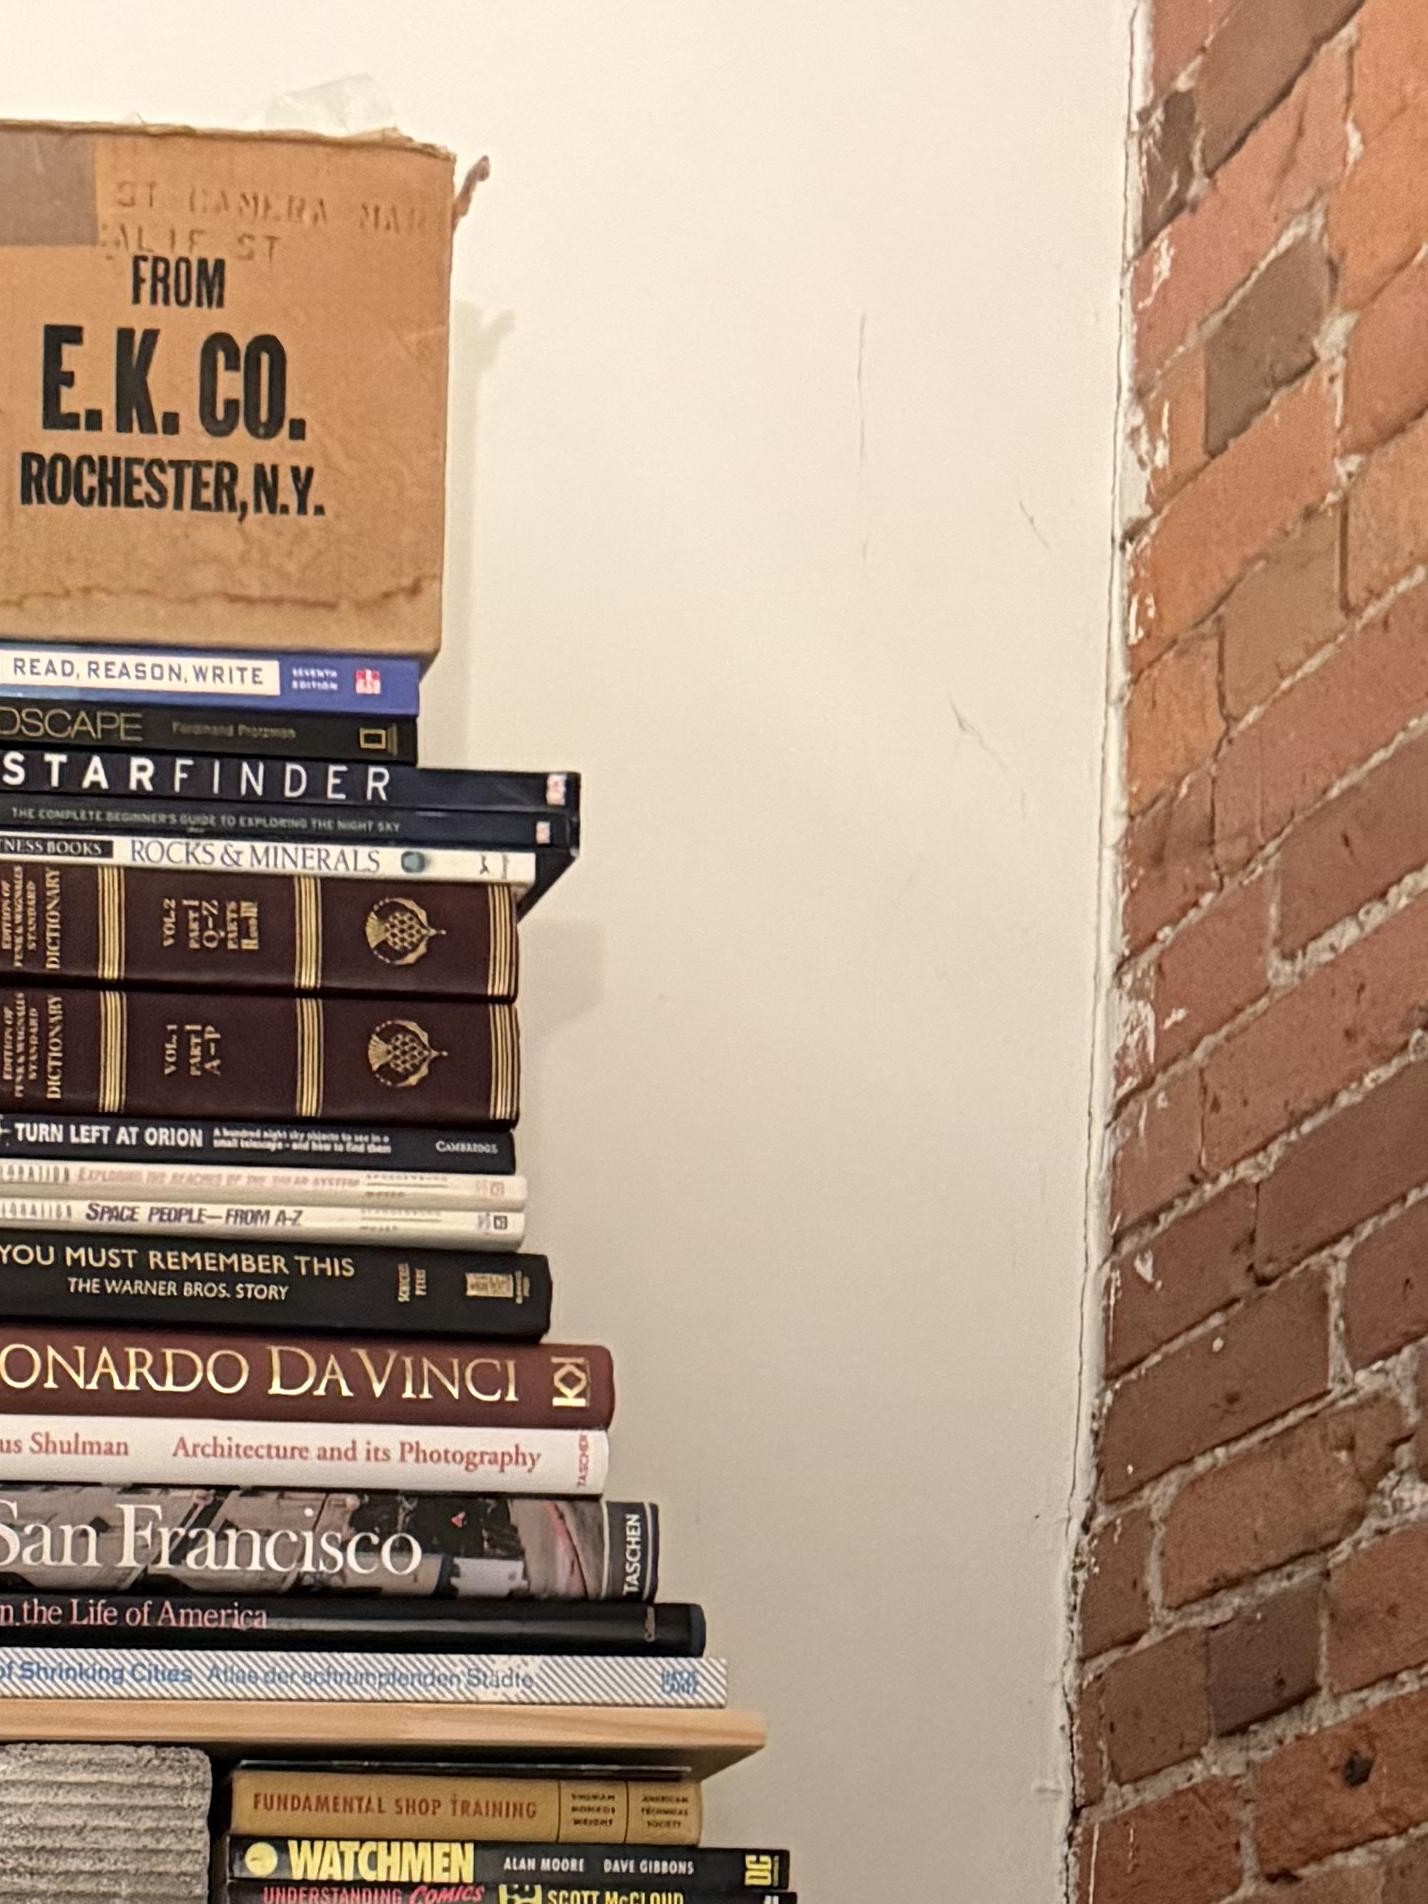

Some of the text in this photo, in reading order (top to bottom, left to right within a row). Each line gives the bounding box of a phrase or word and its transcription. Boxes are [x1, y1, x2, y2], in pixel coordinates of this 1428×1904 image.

[132, 257, 226, 309] FROM
[42, 324, 306, 441] E. K. CO.
[21, 451, 326, 523] ROCHESTER, N.Y.
[13, 658, 263, 686] READ, REASON, WRITE
[2, 751, 390, 800] STARFINDER
[130, 841, 380, 874] ROCKS & MINERALS
[66, 1246, 137, 1269] MUST
[148, 1249, 288, 1275] REMEMBER
[294, 1256, 354, 1277] THIS
[115, 1503, 422, 1577] Francisco
[623, 1513, 642, 1592] TASCHEN
[287, 1841, 474, 1882] WATCHMEN
